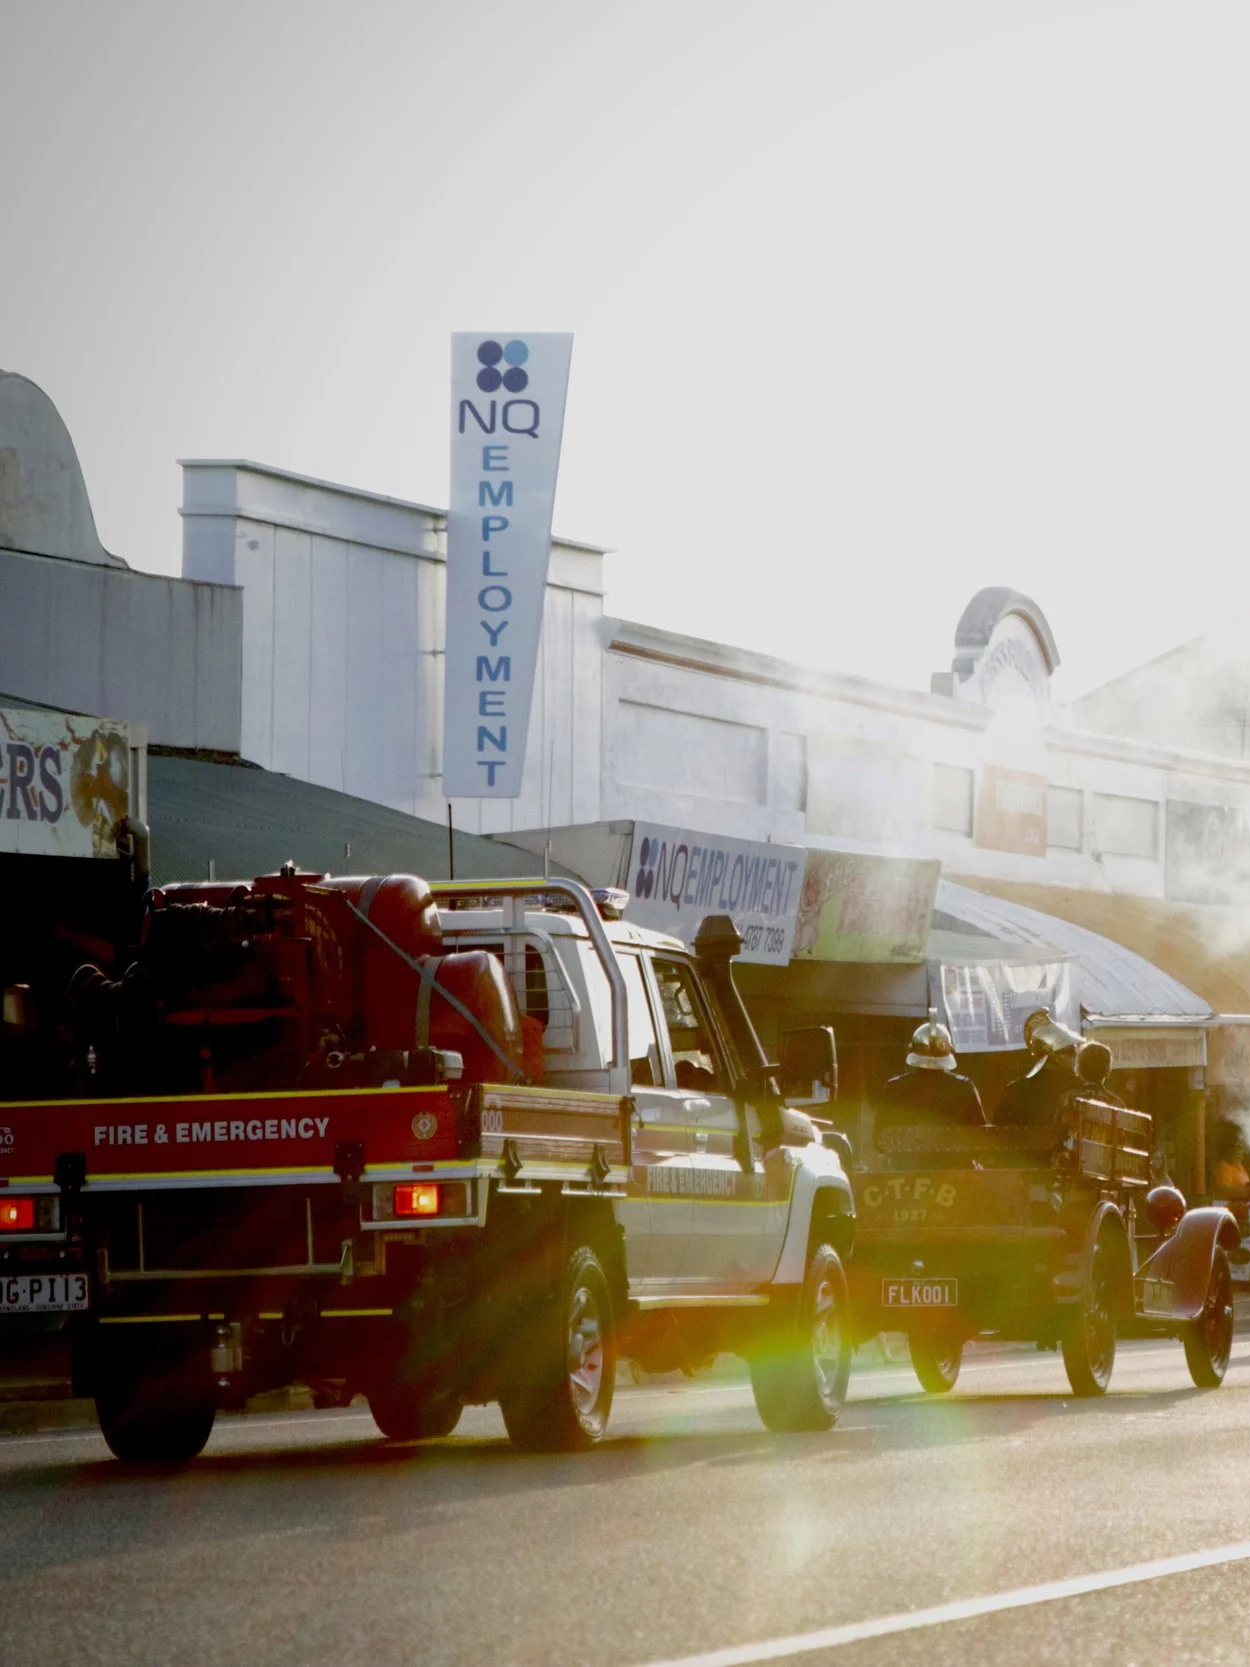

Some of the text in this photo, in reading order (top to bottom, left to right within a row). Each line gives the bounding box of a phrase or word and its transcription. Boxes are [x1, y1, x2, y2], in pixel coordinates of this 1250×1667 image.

[459, 398, 541, 439] NQ
[475, 445, 514, 787] EMPLOYMENT
[0, 743, 63, 824] RS
[93, 1116, 330, 1147] FIRE & EMERGENCY
